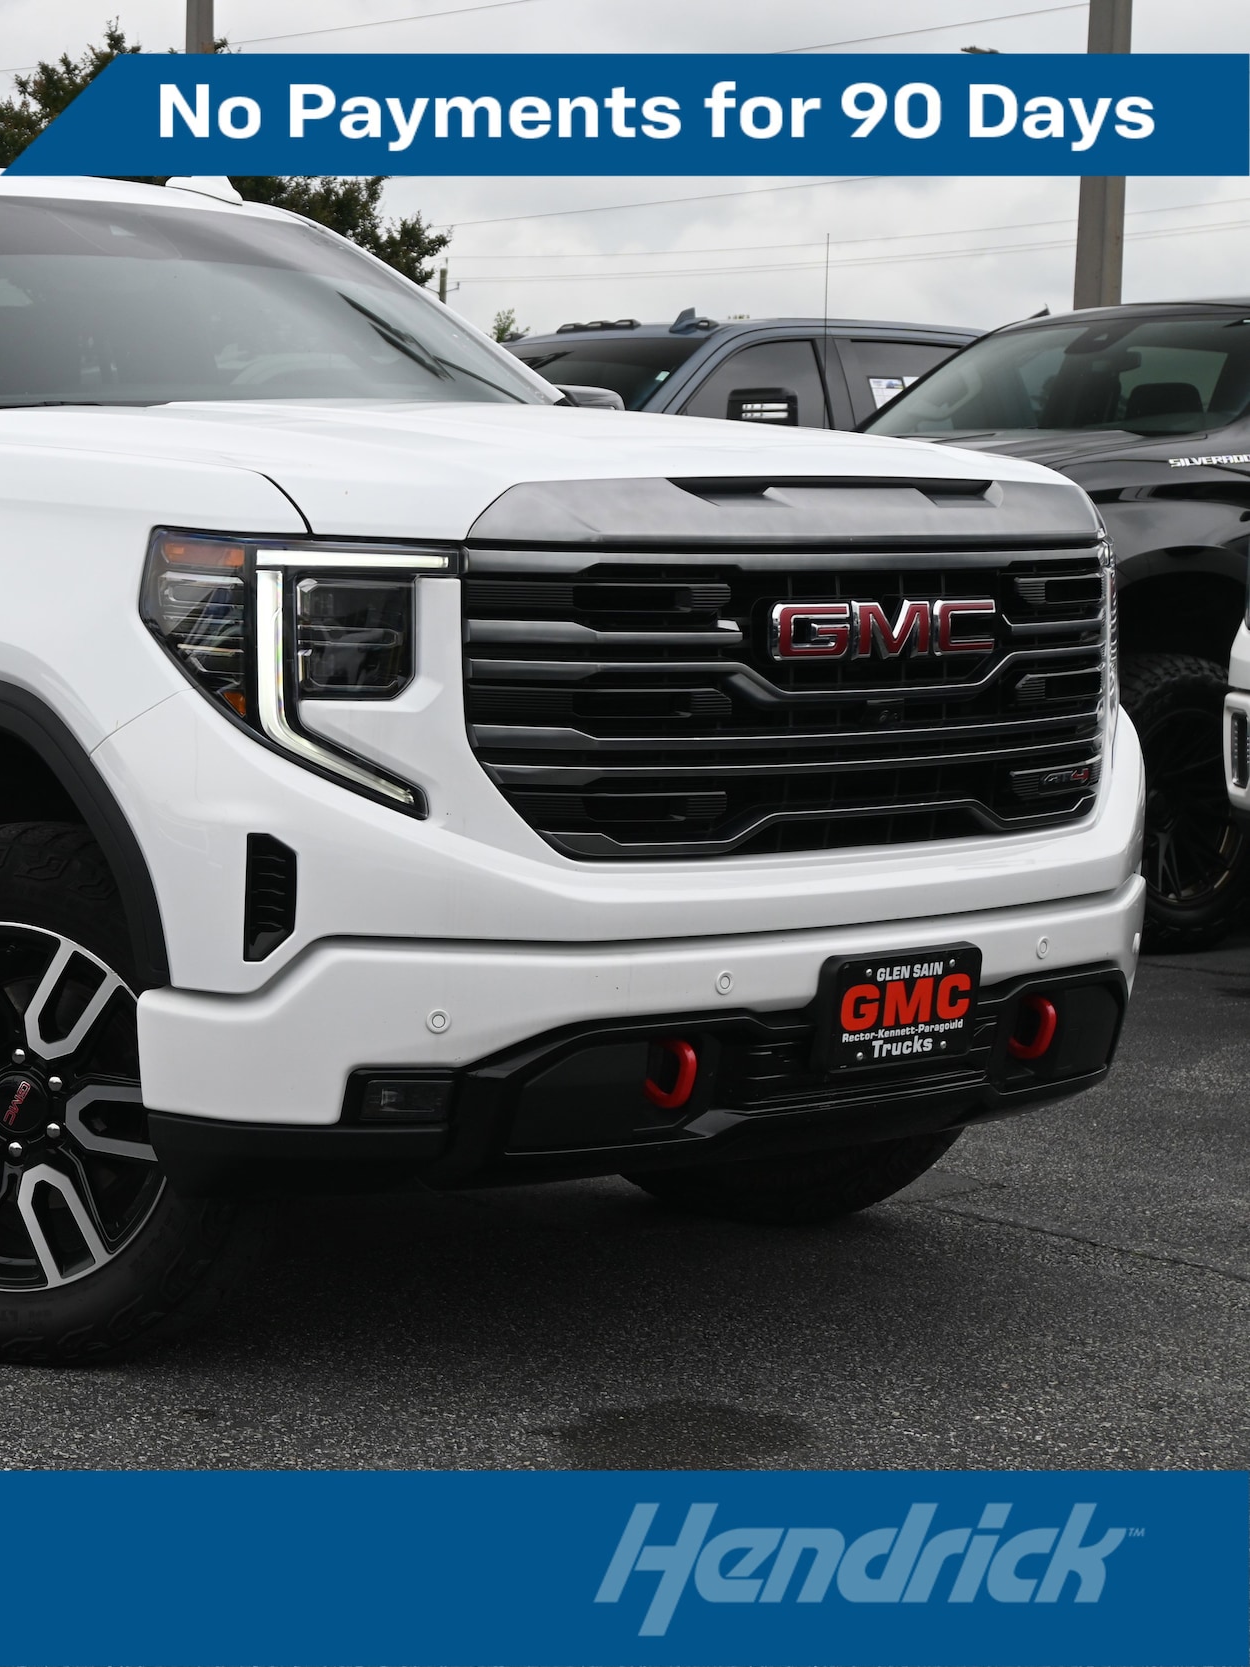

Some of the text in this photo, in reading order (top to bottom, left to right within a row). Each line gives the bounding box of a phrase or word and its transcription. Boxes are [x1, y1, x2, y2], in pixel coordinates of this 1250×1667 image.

[1168, 454, 1250, 467] SILVERADO
[771, 599, 996, 661] GMC
[876, 961, 944, 982] GLEN SAIN
[840, 973, 972, 1032] GMC
[842, 1018, 964, 1043] Rector-Kennett-Paragould
[871, 1035, 934, 1059] Trucks
[2, 1080, 31, 1126] GMC
